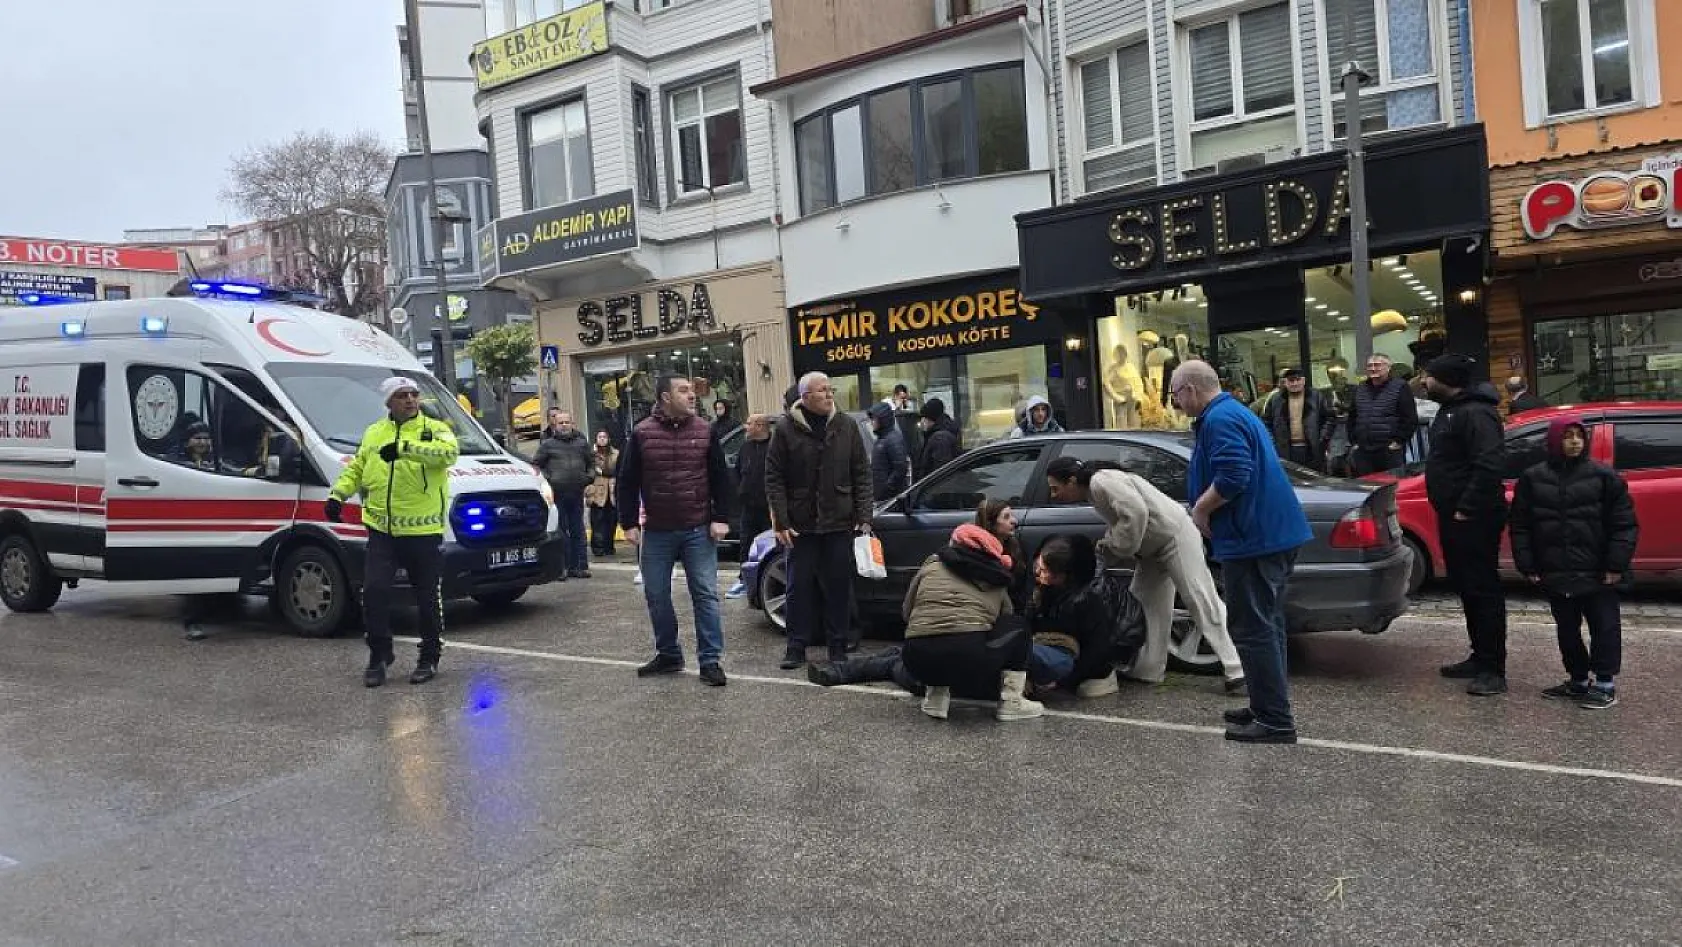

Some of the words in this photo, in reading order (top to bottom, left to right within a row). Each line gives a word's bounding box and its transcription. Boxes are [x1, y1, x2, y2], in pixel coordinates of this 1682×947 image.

[510, 48, 549, 69] SANAT
[532, 209, 595, 243] ALDEMİR
[600, 204, 632, 228] YAPI
[28, 243, 120, 266] NOTER
[577, 283, 717, 346] SELDA
[798, 304, 878, 346] İZMİR
[826, 343, 872, 362] SÖĞÜŞ
[897, 331, 955, 353] KOSOVA
[958, 325, 1011, 346] KÖFTE
[15, 395, 69, 416] BAKANLIĞI
[15, 417, 52, 440] SAĞLIK
